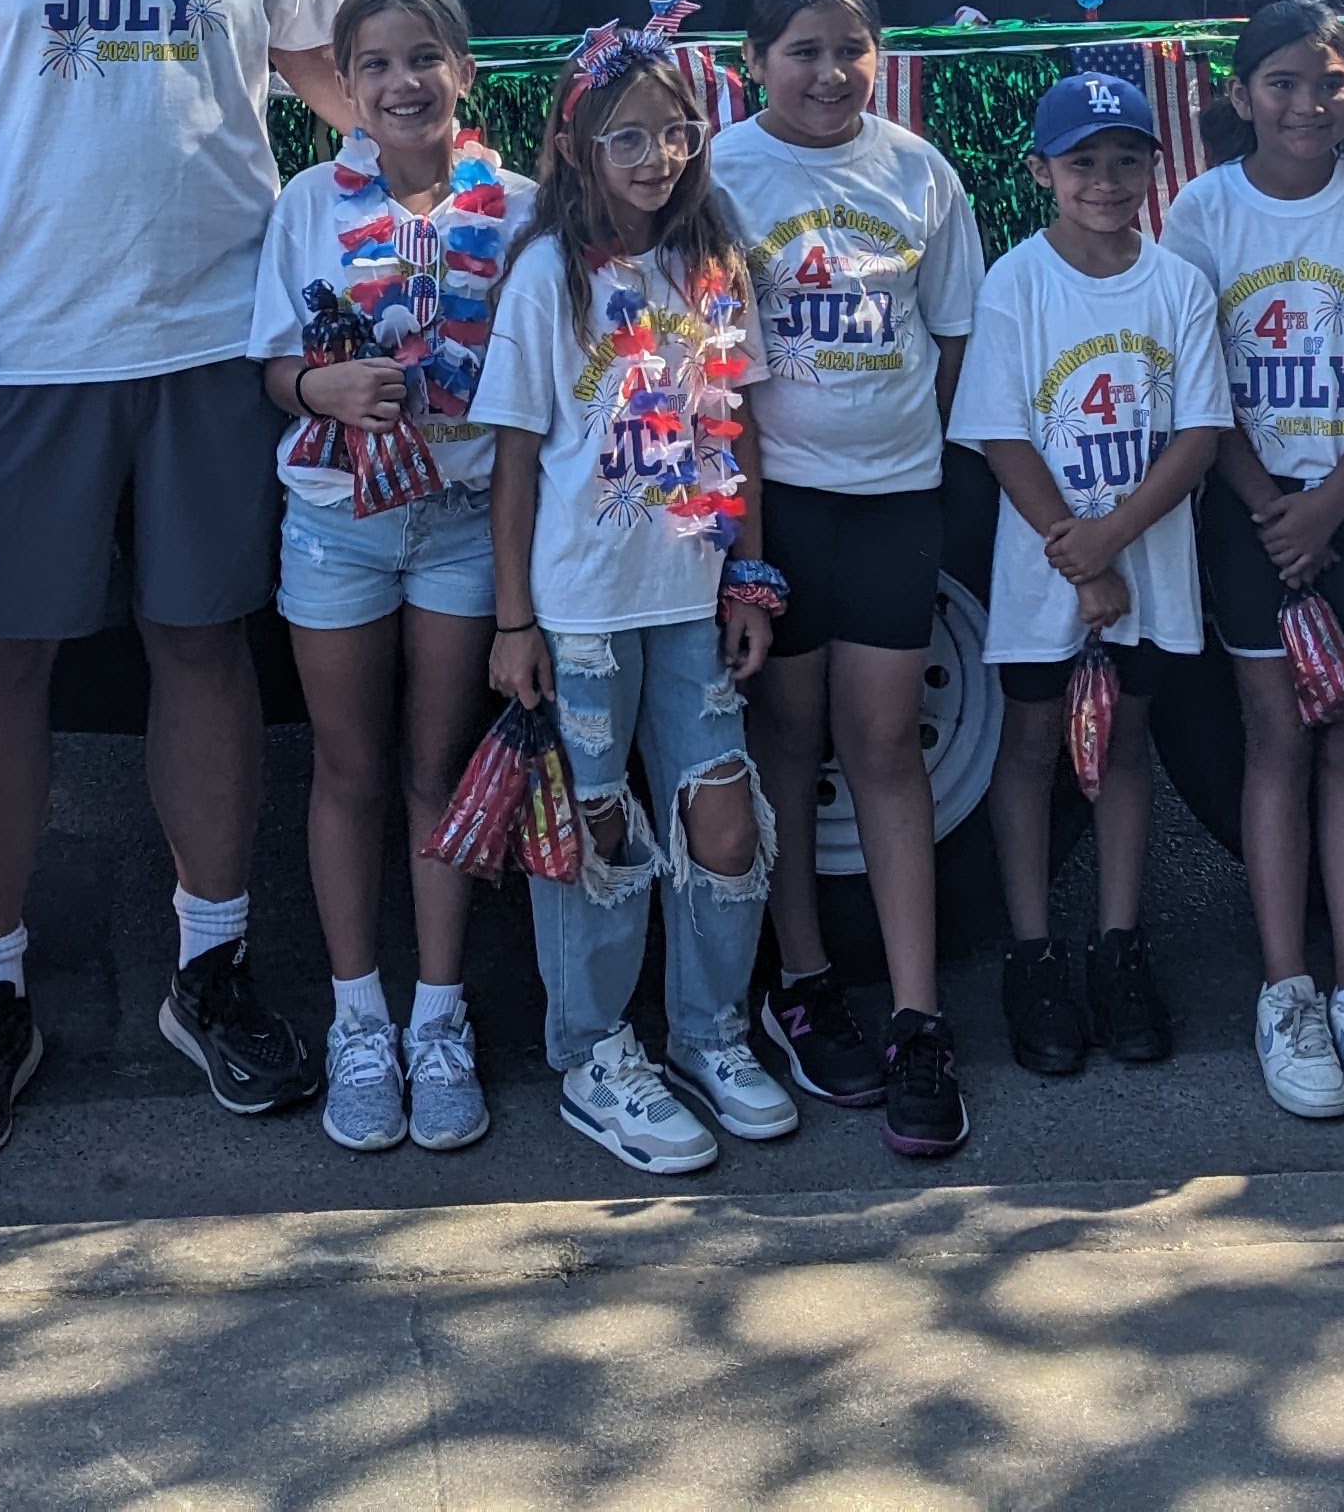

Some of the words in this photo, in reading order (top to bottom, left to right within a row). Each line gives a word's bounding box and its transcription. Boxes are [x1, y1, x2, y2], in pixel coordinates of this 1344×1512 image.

[97, 41, 139, 62] 2024
[141, 40, 198, 61] Parade
[1085, 80, 1121, 114] LA
[1254, 299, 1309, 349] 4TH
[1304, 337, 1324, 354] OF
[815, 350, 854, 371] 2024
[856, 350, 903, 371] Parade
[1081, 373, 1135, 425] 4TH
[1132, 409, 1150, 428] OF
